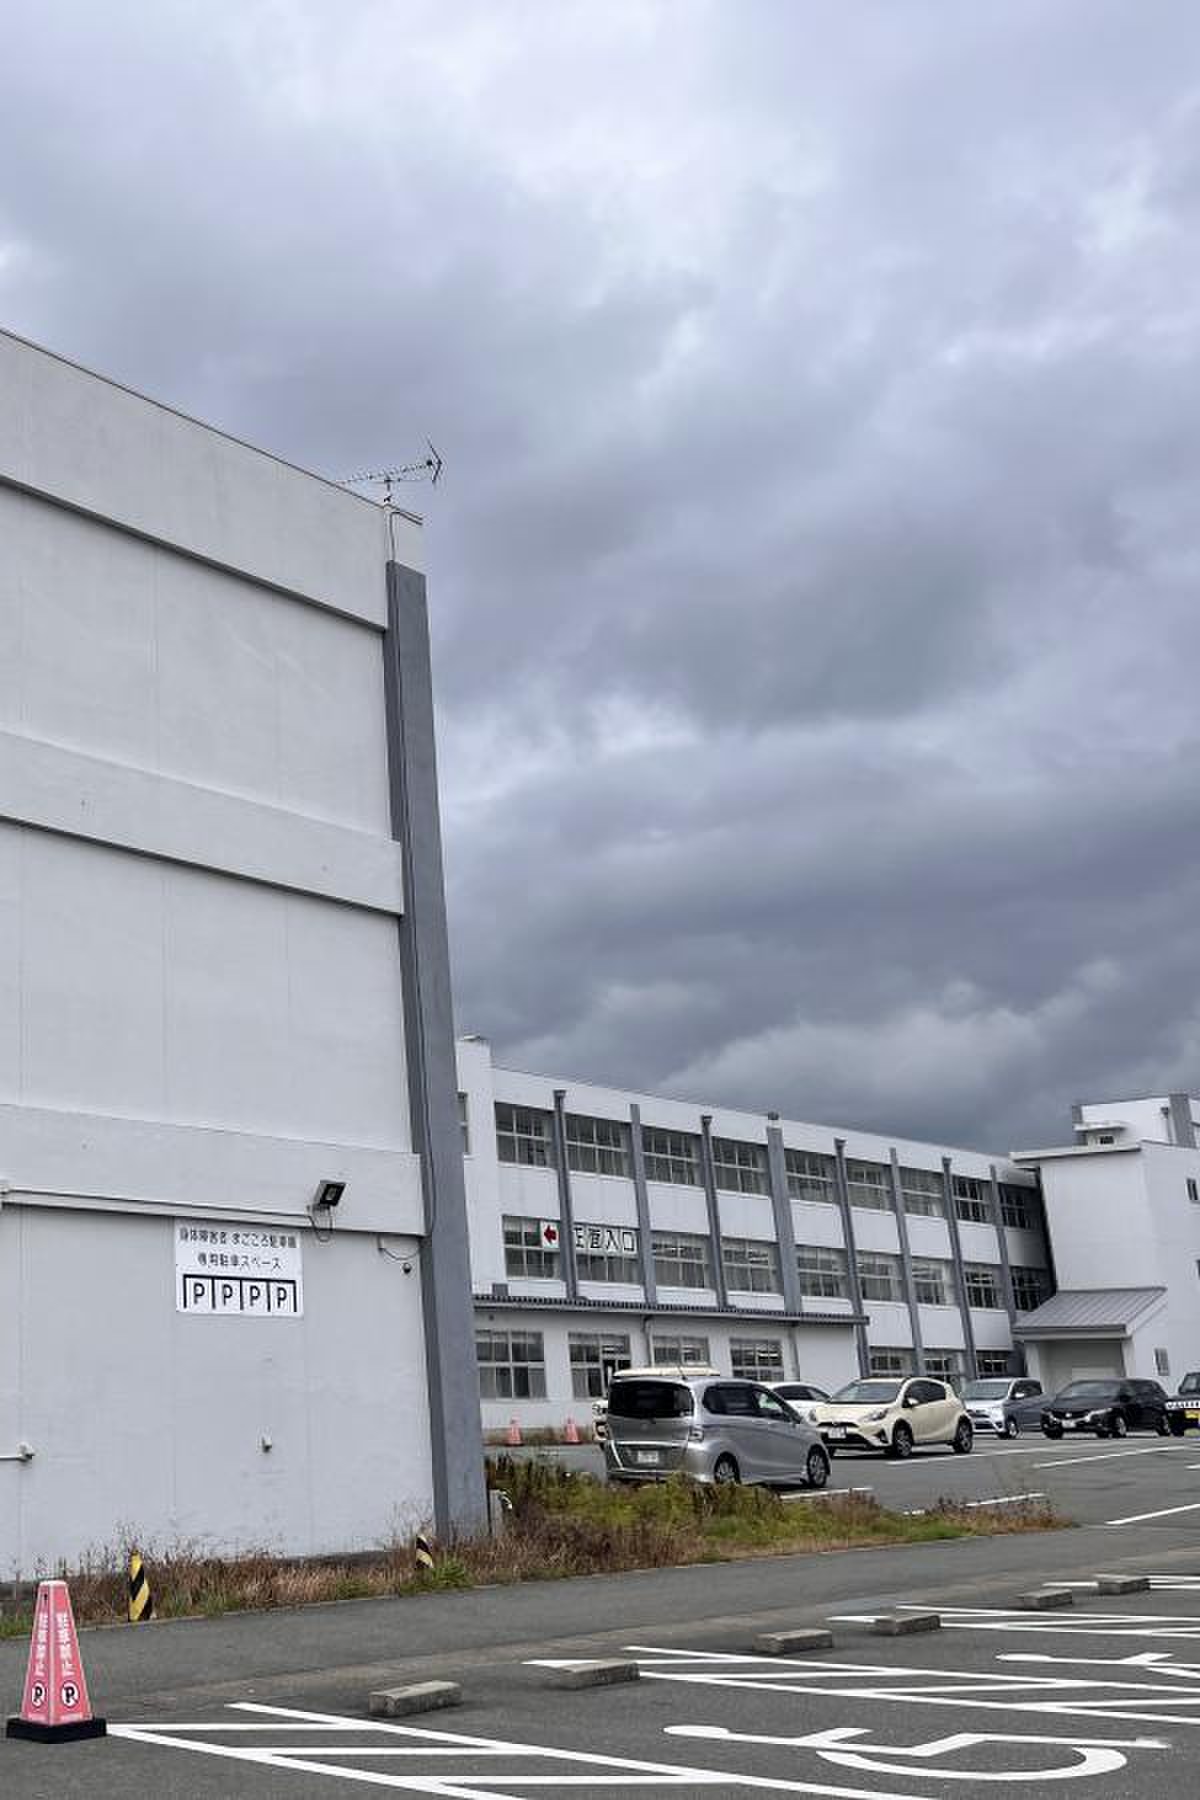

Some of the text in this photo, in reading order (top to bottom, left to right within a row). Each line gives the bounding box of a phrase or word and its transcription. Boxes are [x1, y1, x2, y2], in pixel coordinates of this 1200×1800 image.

[193, 1282, 287, 1309] P P P P
